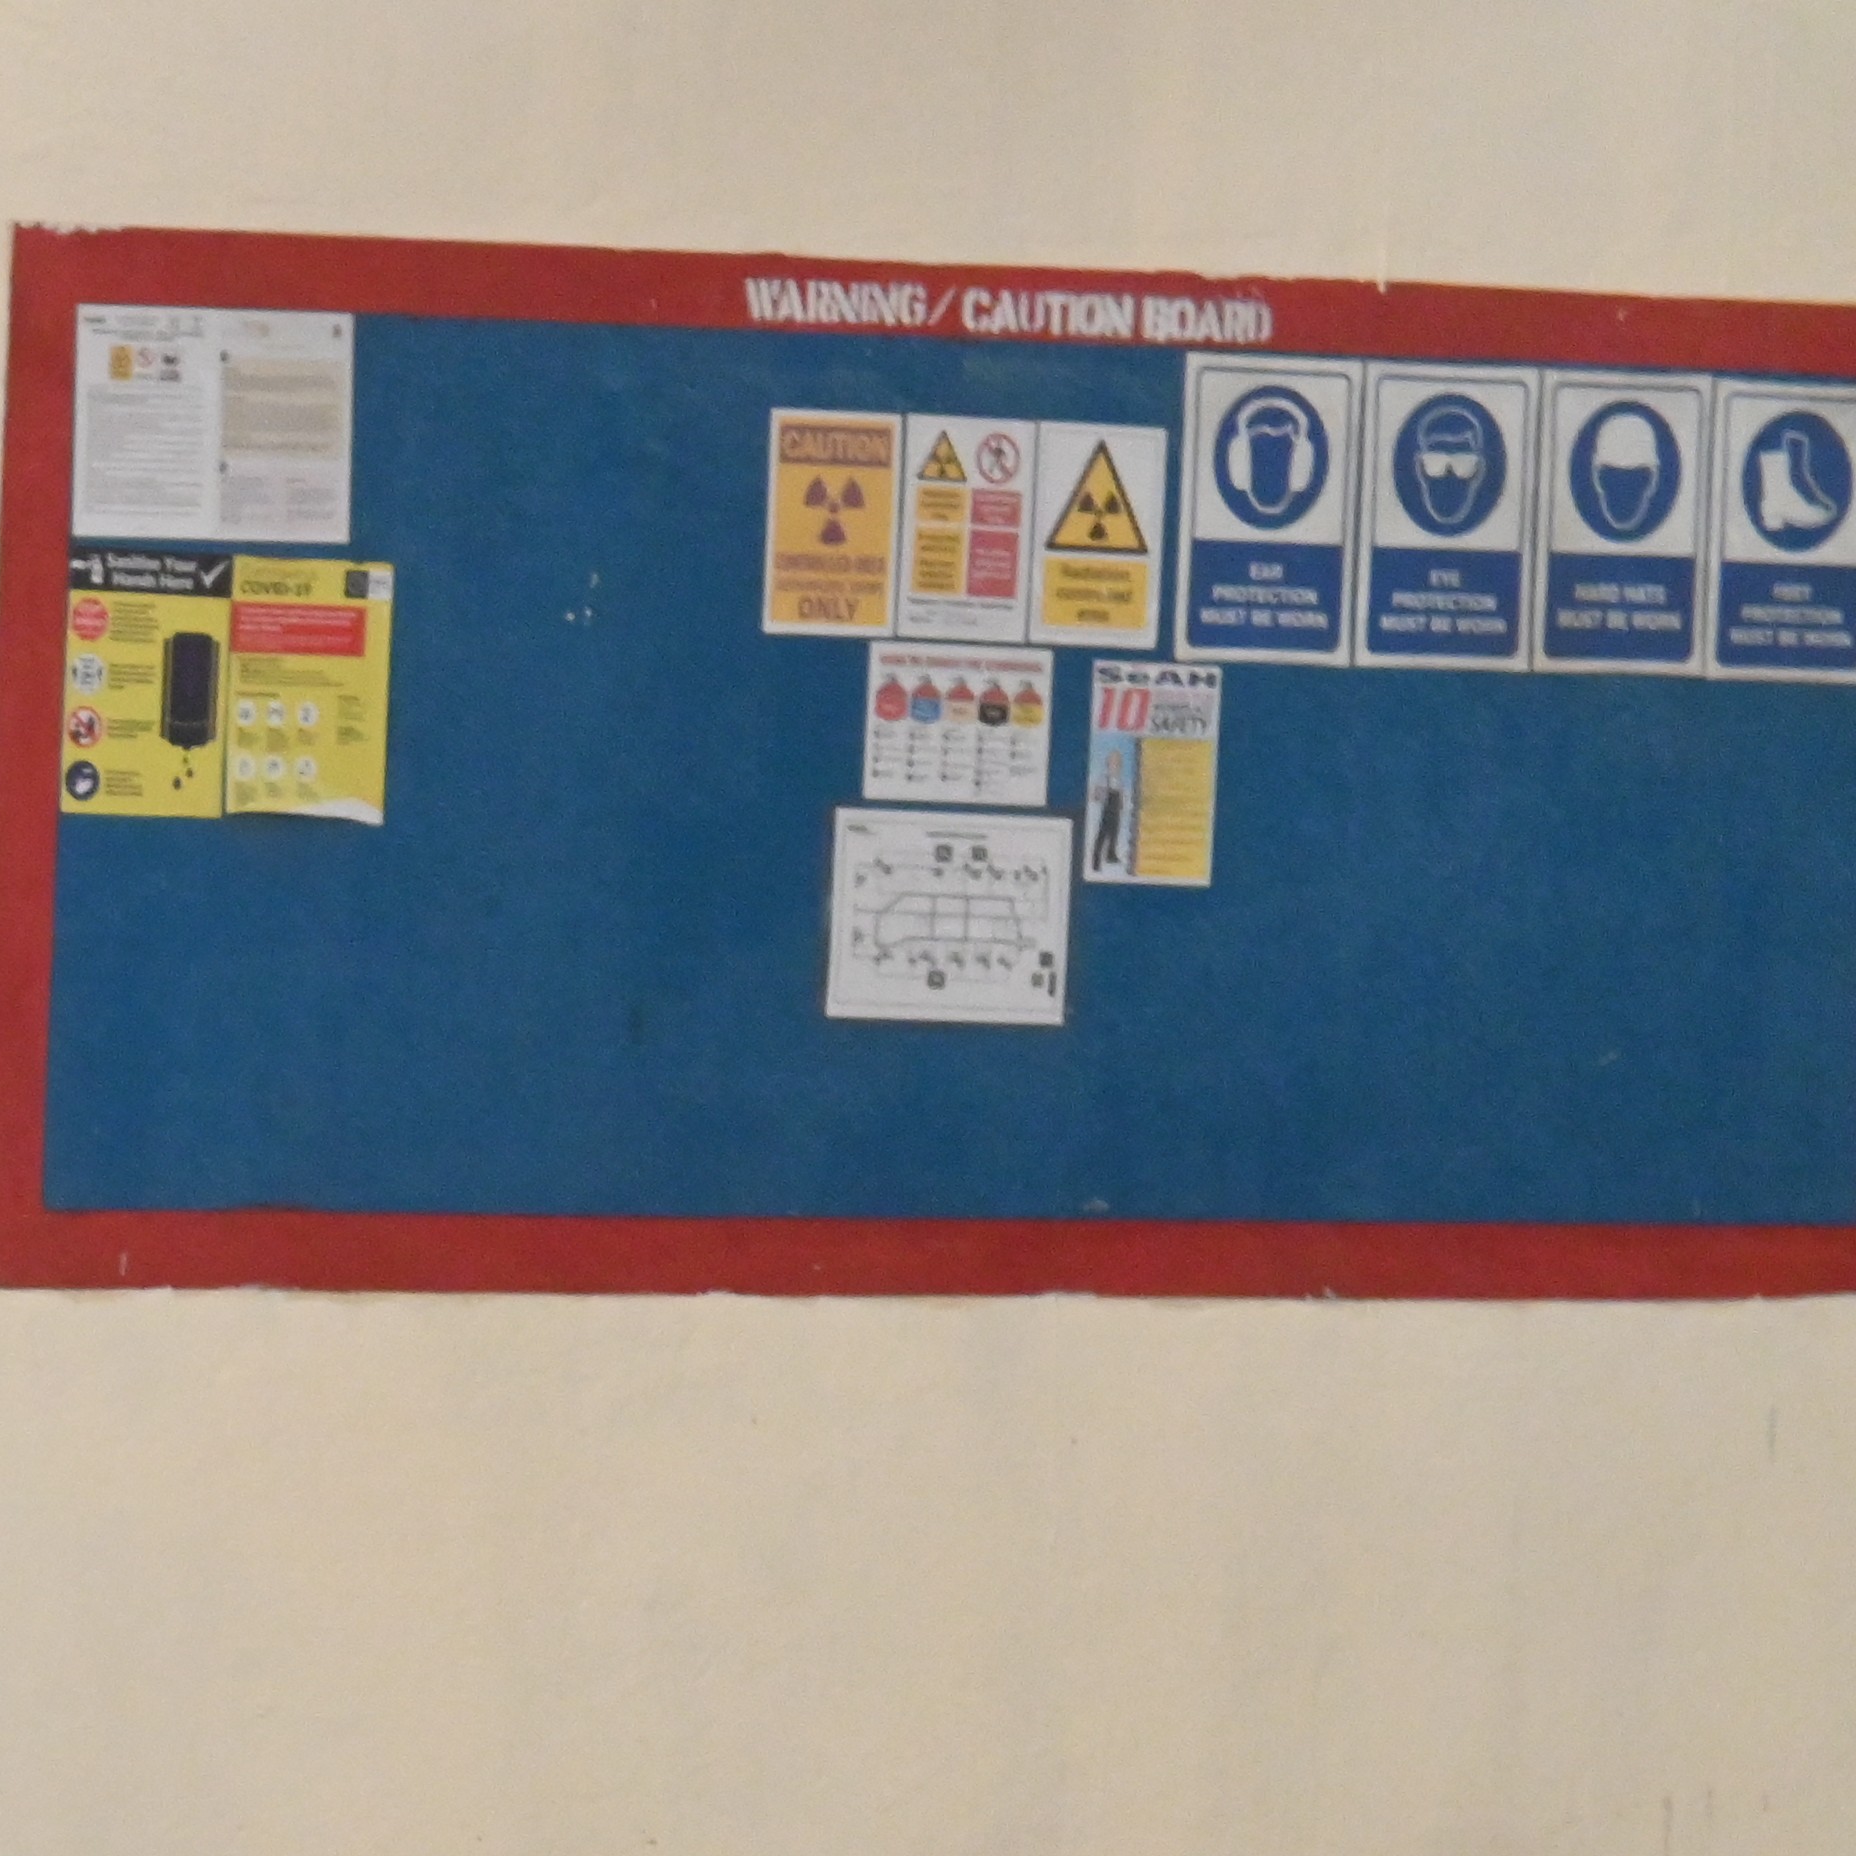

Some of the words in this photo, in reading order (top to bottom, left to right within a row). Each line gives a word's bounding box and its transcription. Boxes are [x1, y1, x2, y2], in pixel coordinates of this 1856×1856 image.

[961, 286, 1132, 338] CAUTION
[1141, 294, 1274, 344] BOARD
[783, 430, 888, 462] CAUTION
[797, 596, 859, 620] ONLY
[1098, 687, 1151, 731] 10
